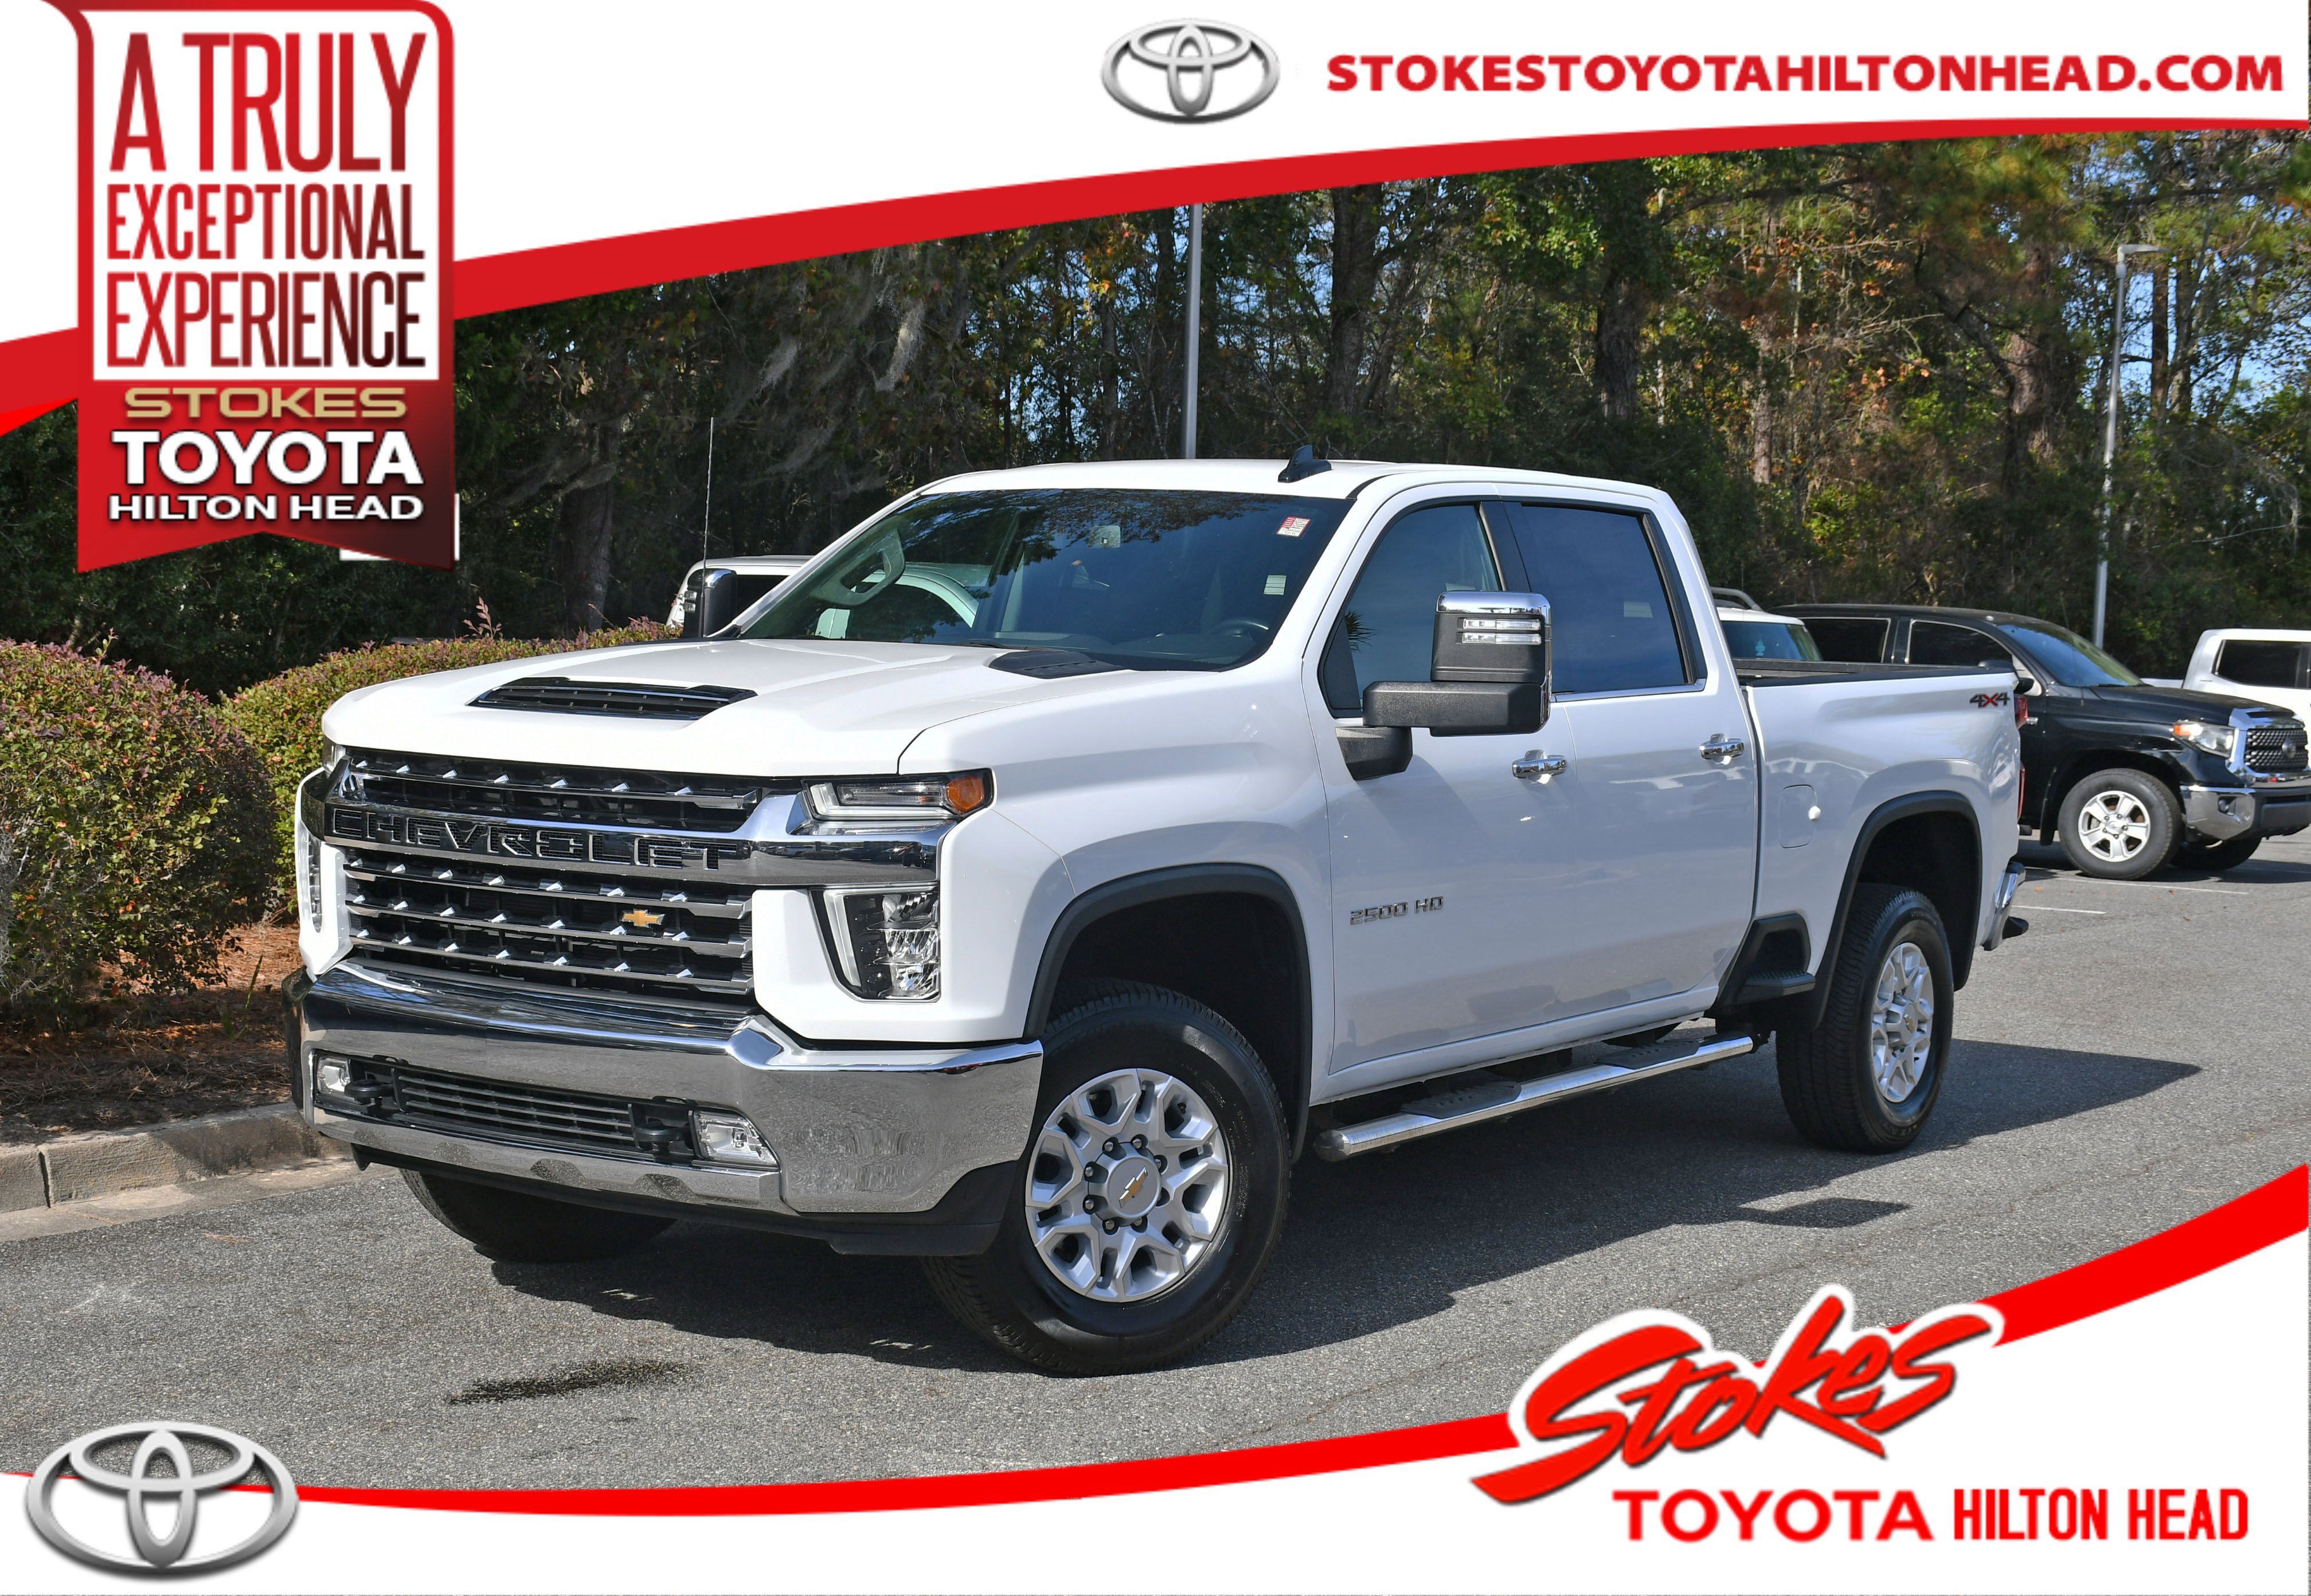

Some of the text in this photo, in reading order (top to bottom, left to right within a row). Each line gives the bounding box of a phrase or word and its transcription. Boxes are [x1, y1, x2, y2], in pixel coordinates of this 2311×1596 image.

[333, 807, 738, 871] CHEVROLET
[1350, 896, 1444, 925] 2500 HD
